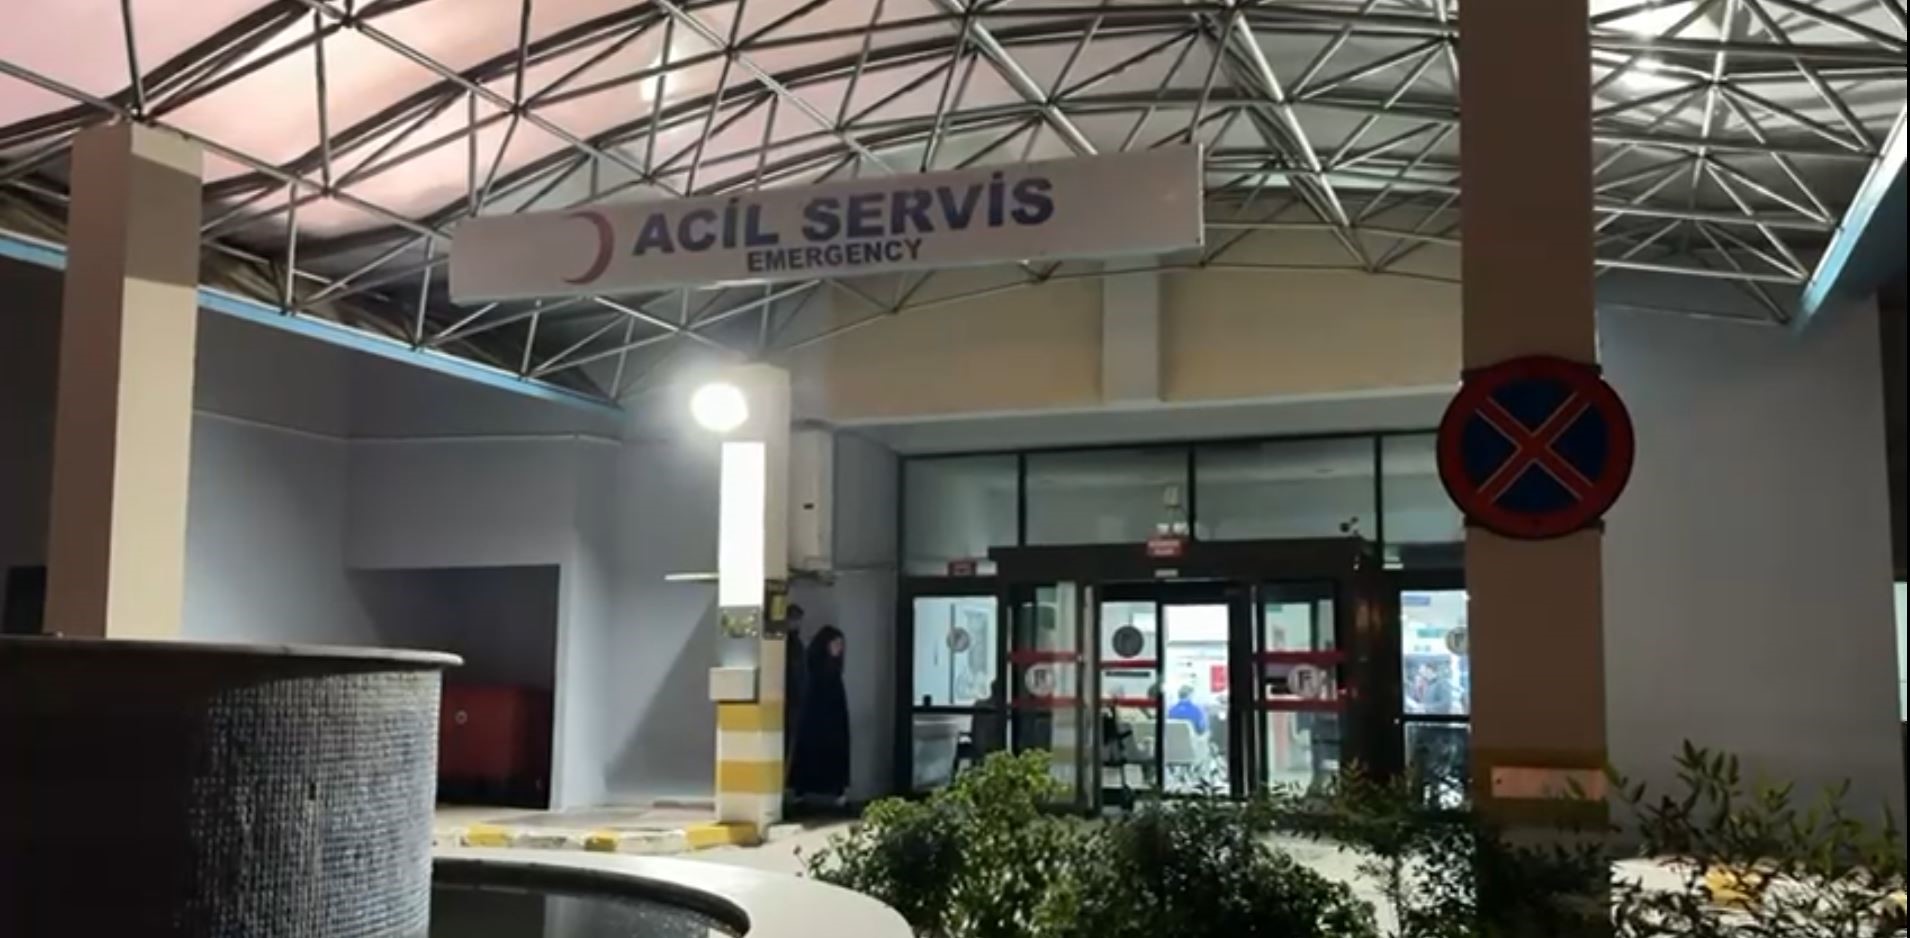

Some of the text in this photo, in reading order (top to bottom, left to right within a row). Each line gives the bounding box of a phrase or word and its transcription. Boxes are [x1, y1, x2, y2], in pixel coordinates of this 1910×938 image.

[632, 171, 1054, 256] ACİL SERVİS
[747, 238, 922, 272] EMERGENCY
